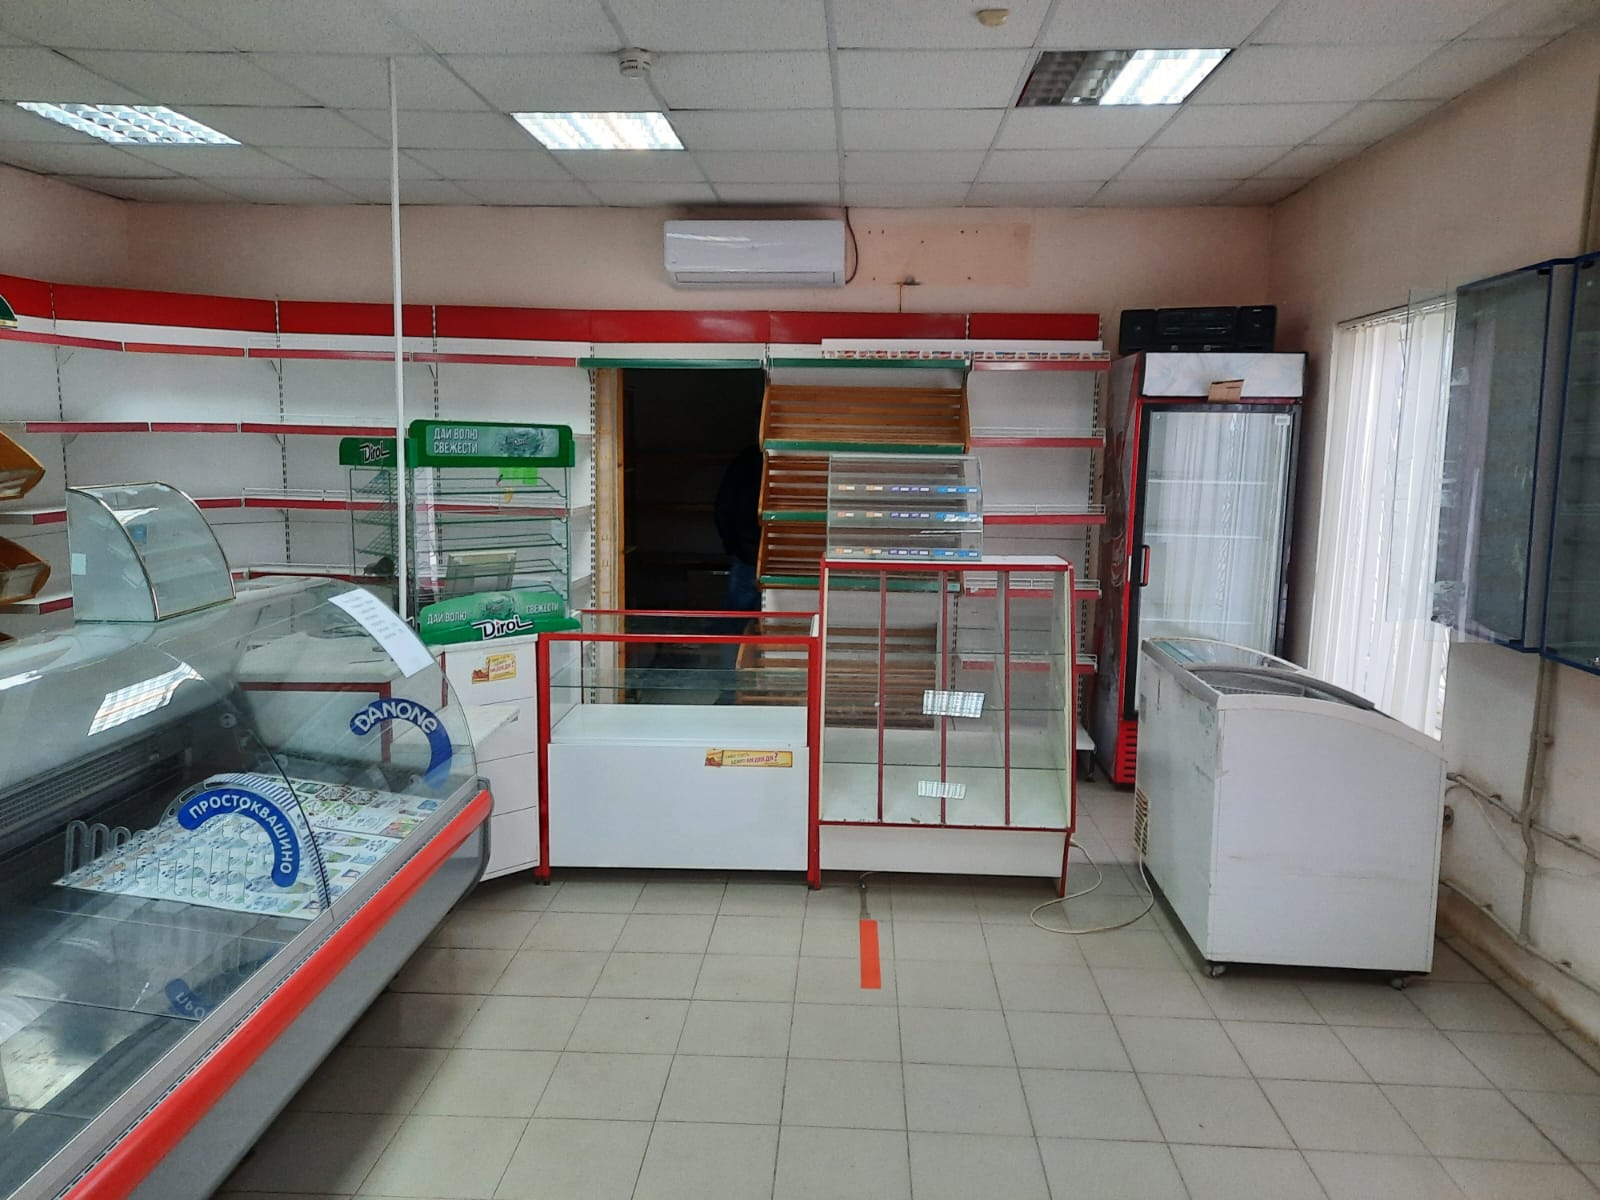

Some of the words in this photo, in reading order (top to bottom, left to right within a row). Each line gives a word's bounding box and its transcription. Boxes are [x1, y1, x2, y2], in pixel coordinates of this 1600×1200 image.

[453, 428, 478, 440] ВОЛЮ
[433, 441, 478, 454] СВЕЖЕСТИ
[445, 611, 467, 623] ВОЛЮ
[188, 794, 294, 874] ПРОСТОКВАШИНО
